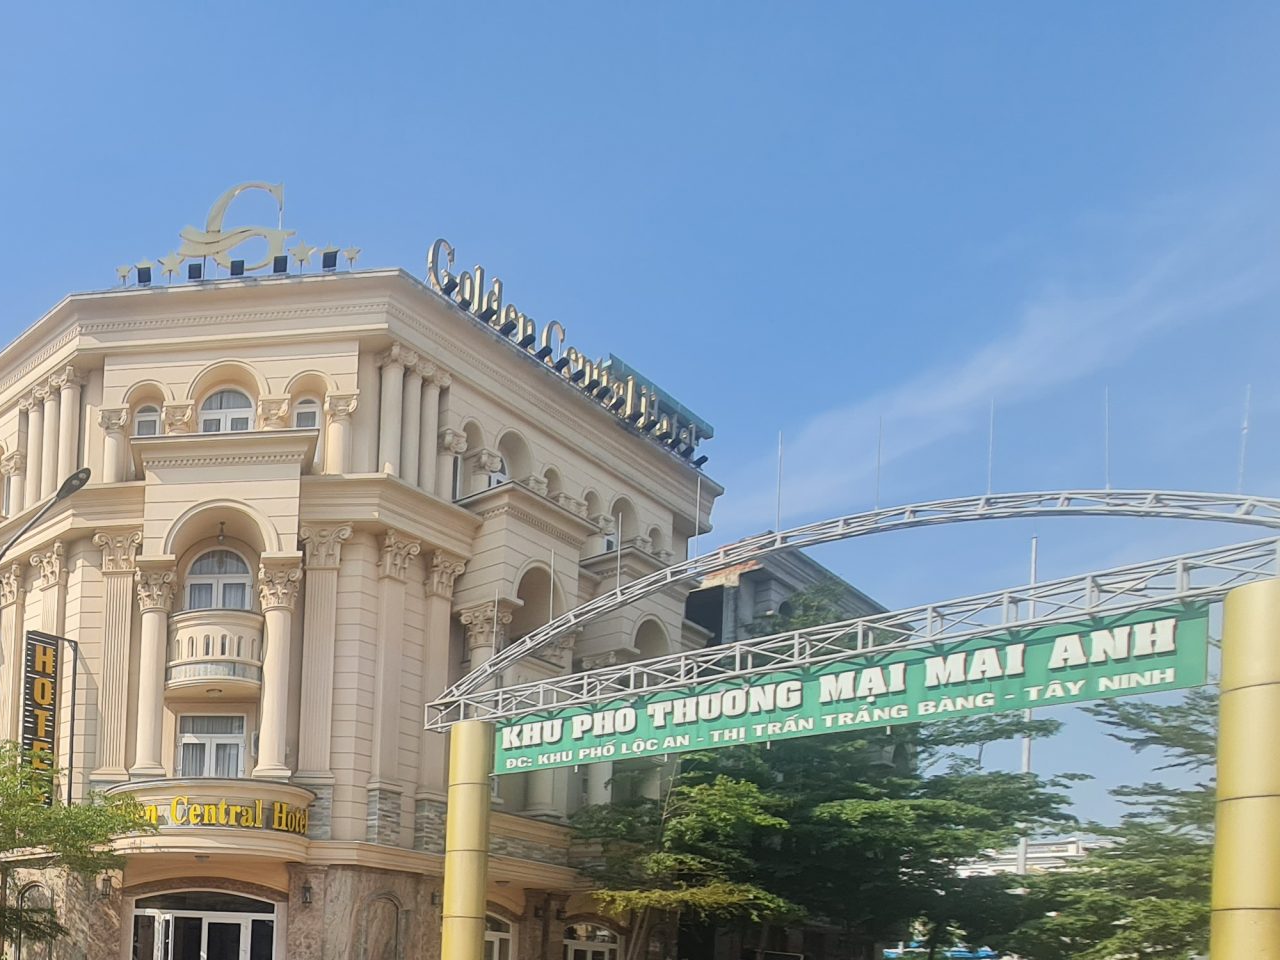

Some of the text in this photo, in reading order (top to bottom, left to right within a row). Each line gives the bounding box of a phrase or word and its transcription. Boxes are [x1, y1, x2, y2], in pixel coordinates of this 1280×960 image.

[427, 238, 536, 347] Golden
[540, 320, 635, 420] Central
[502, 719, 564, 749] KHU
[647, 680, 803, 727] THƯƠNG
[820, 662, 907, 703] MẠI
[924, 643, 1025, 688] MAI
[1047, 618, 1176, 670] ANH
[505, 757, 533, 769] ĐC:
[538, 750, 573, 764] KHU
[579, 739, 616, 760] PHỐ
[621, 738, 659, 756] LỘC
[663, 735, 690, 749] AN
[710, 726, 746, 743] THỊ
[752, 714, 815, 738] TRẤN
[918, 692, 995, 716] BÀNG
[1024, 680, 1088, 700] TÂY
[1097, 668, 1176, 692] NINH
[170, 795, 263, 827] Central
[272, 800, 309, 834] Hotel
